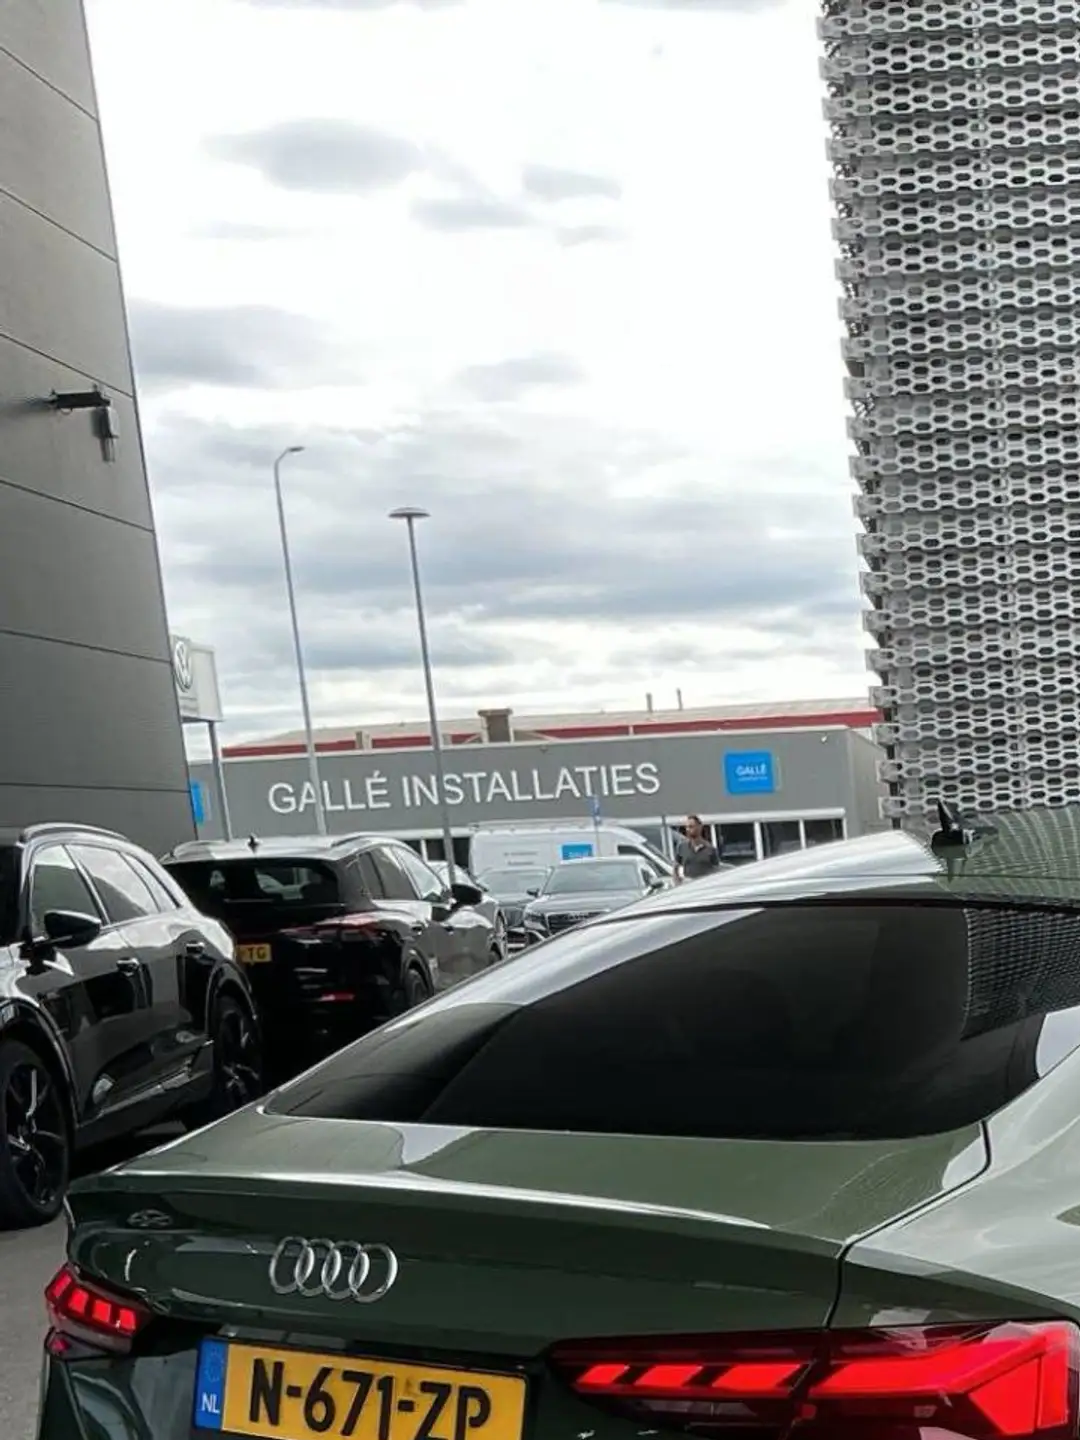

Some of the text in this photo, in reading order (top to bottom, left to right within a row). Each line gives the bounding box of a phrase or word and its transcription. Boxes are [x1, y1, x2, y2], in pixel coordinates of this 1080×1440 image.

[268, 762, 661, 815] GALLÉ INSTALLATIES
[201, 1393, 221, 1414] NL
